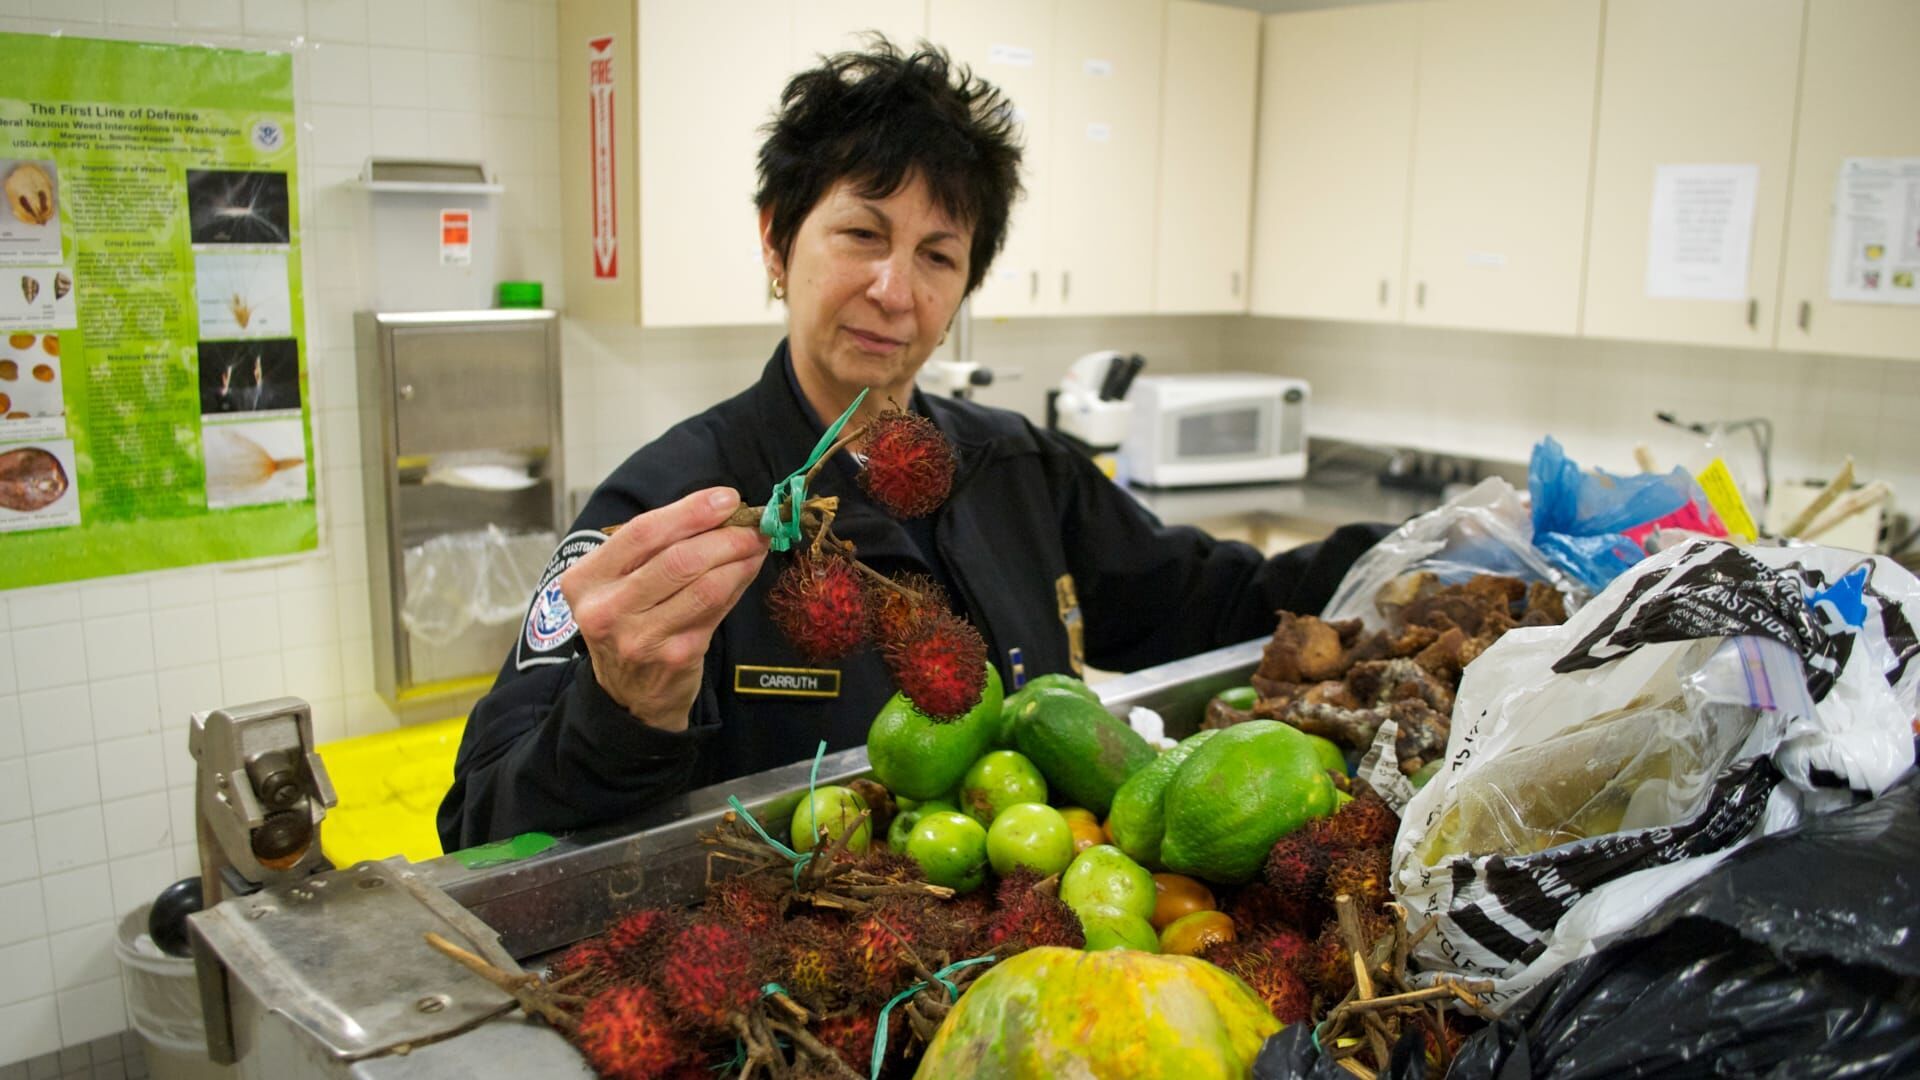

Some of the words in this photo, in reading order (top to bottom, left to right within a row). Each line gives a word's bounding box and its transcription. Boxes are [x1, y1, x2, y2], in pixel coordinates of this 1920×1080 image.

[590, 58, 613, 84] FIRE
[30, 103, 55, 115] The
[61, 104, 91, 117] First
[96, 107, 125, 119] Line
[129, 109, 142, 119] of
[146, 109, 199, 121] Defense
[184, 125, 241, 137] Washington
[1751, 608, 1792, 641] SIDE
[759, 674, 818, 689] CARRUTH
